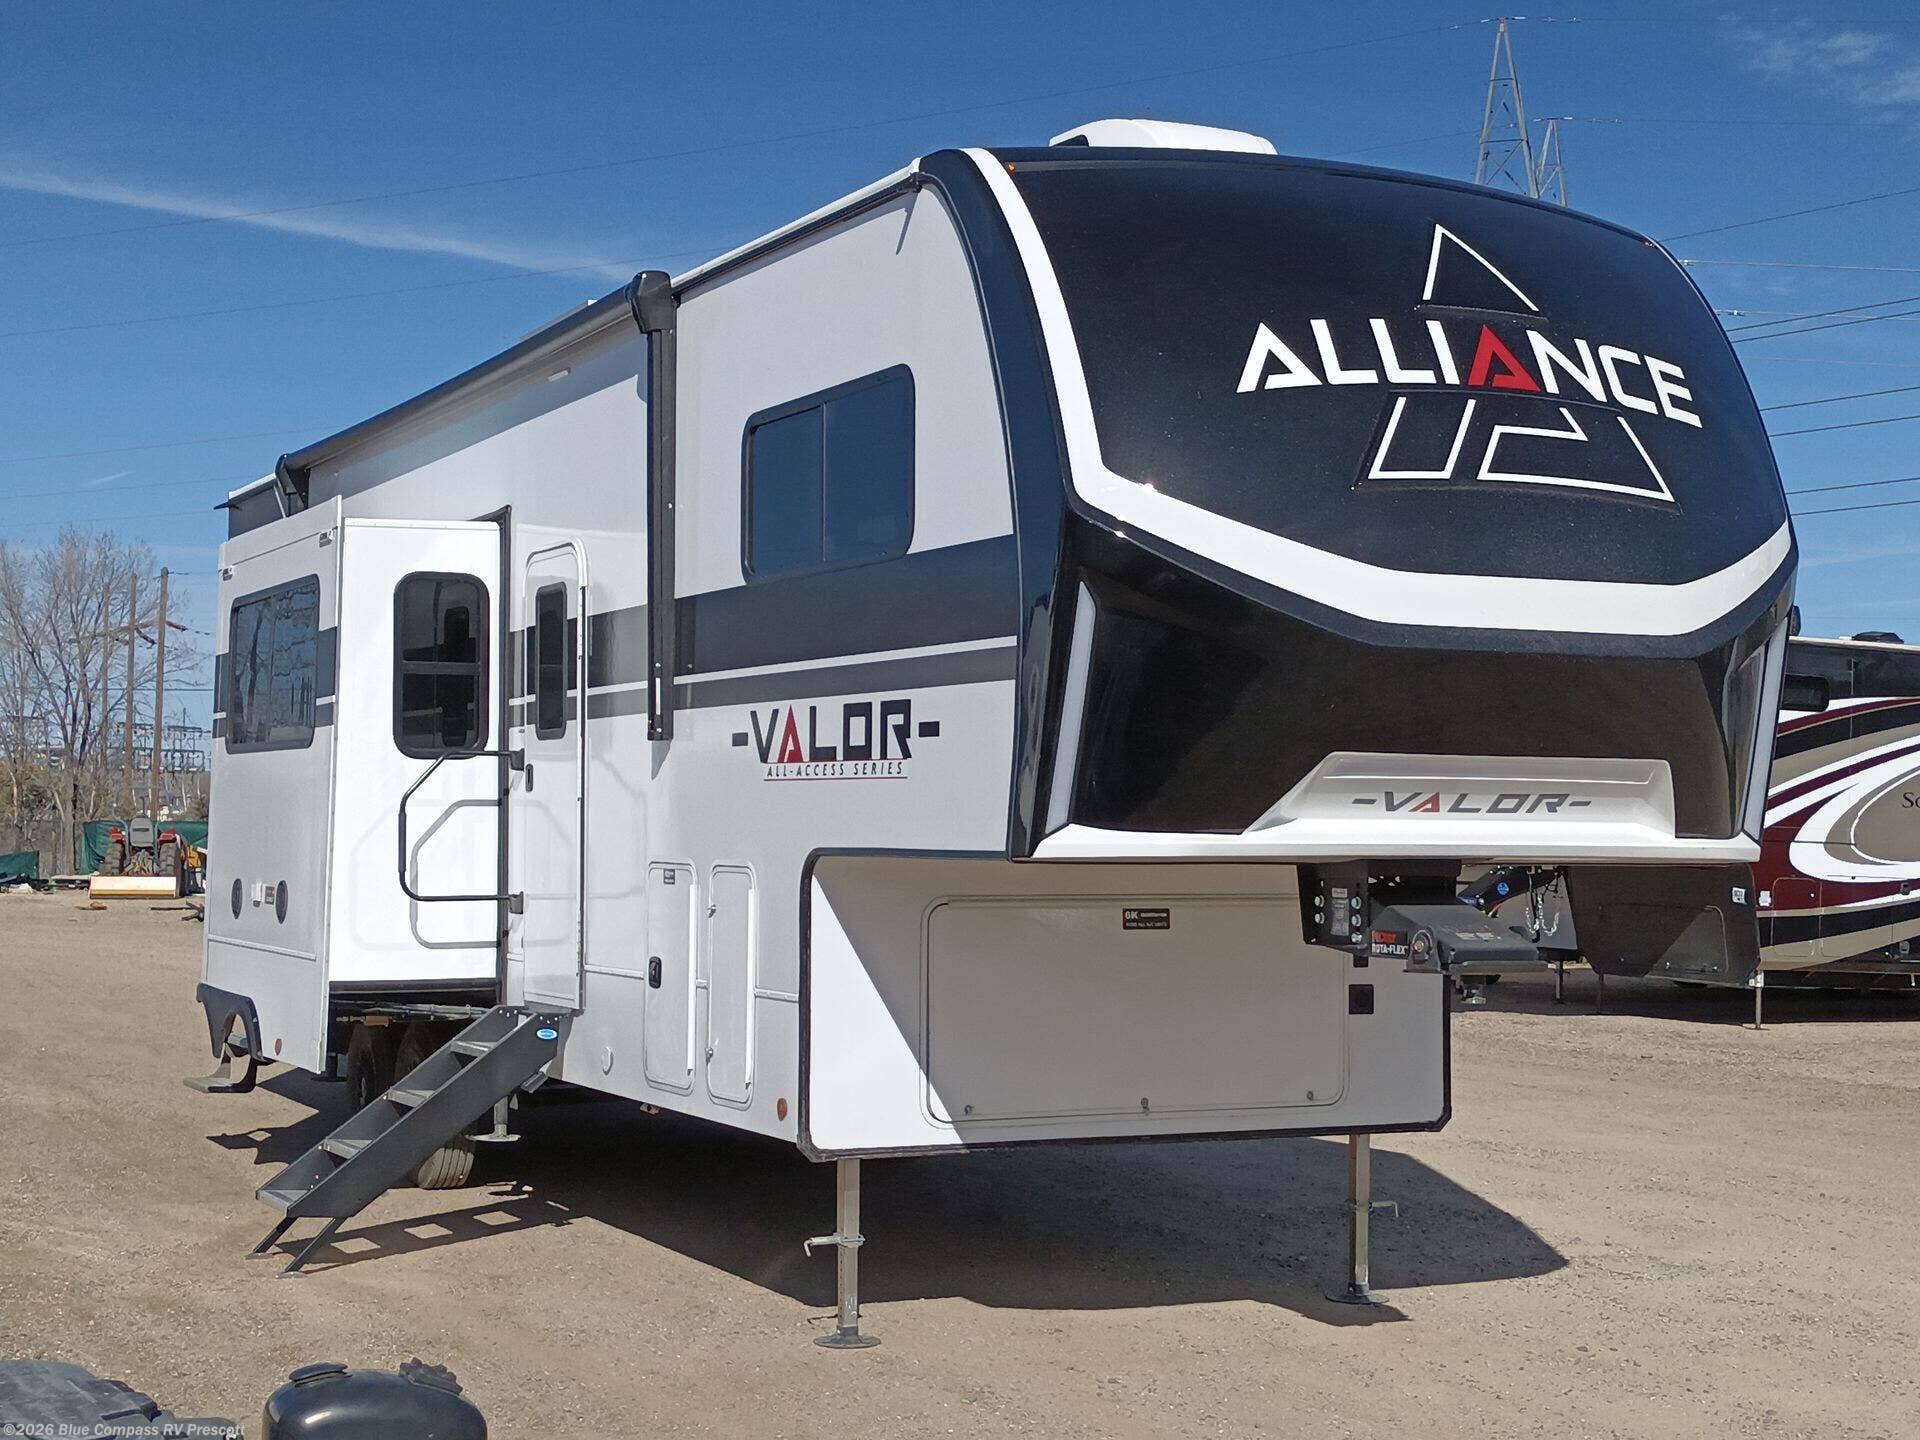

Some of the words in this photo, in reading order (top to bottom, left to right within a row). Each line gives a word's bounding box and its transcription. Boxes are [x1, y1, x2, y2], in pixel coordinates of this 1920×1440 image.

[1236, 317, 1703, 429] ALLIANCE
[767, 764, 844, 777] ALL-ACCESS
[853, 762, 903, 776] SERIES
